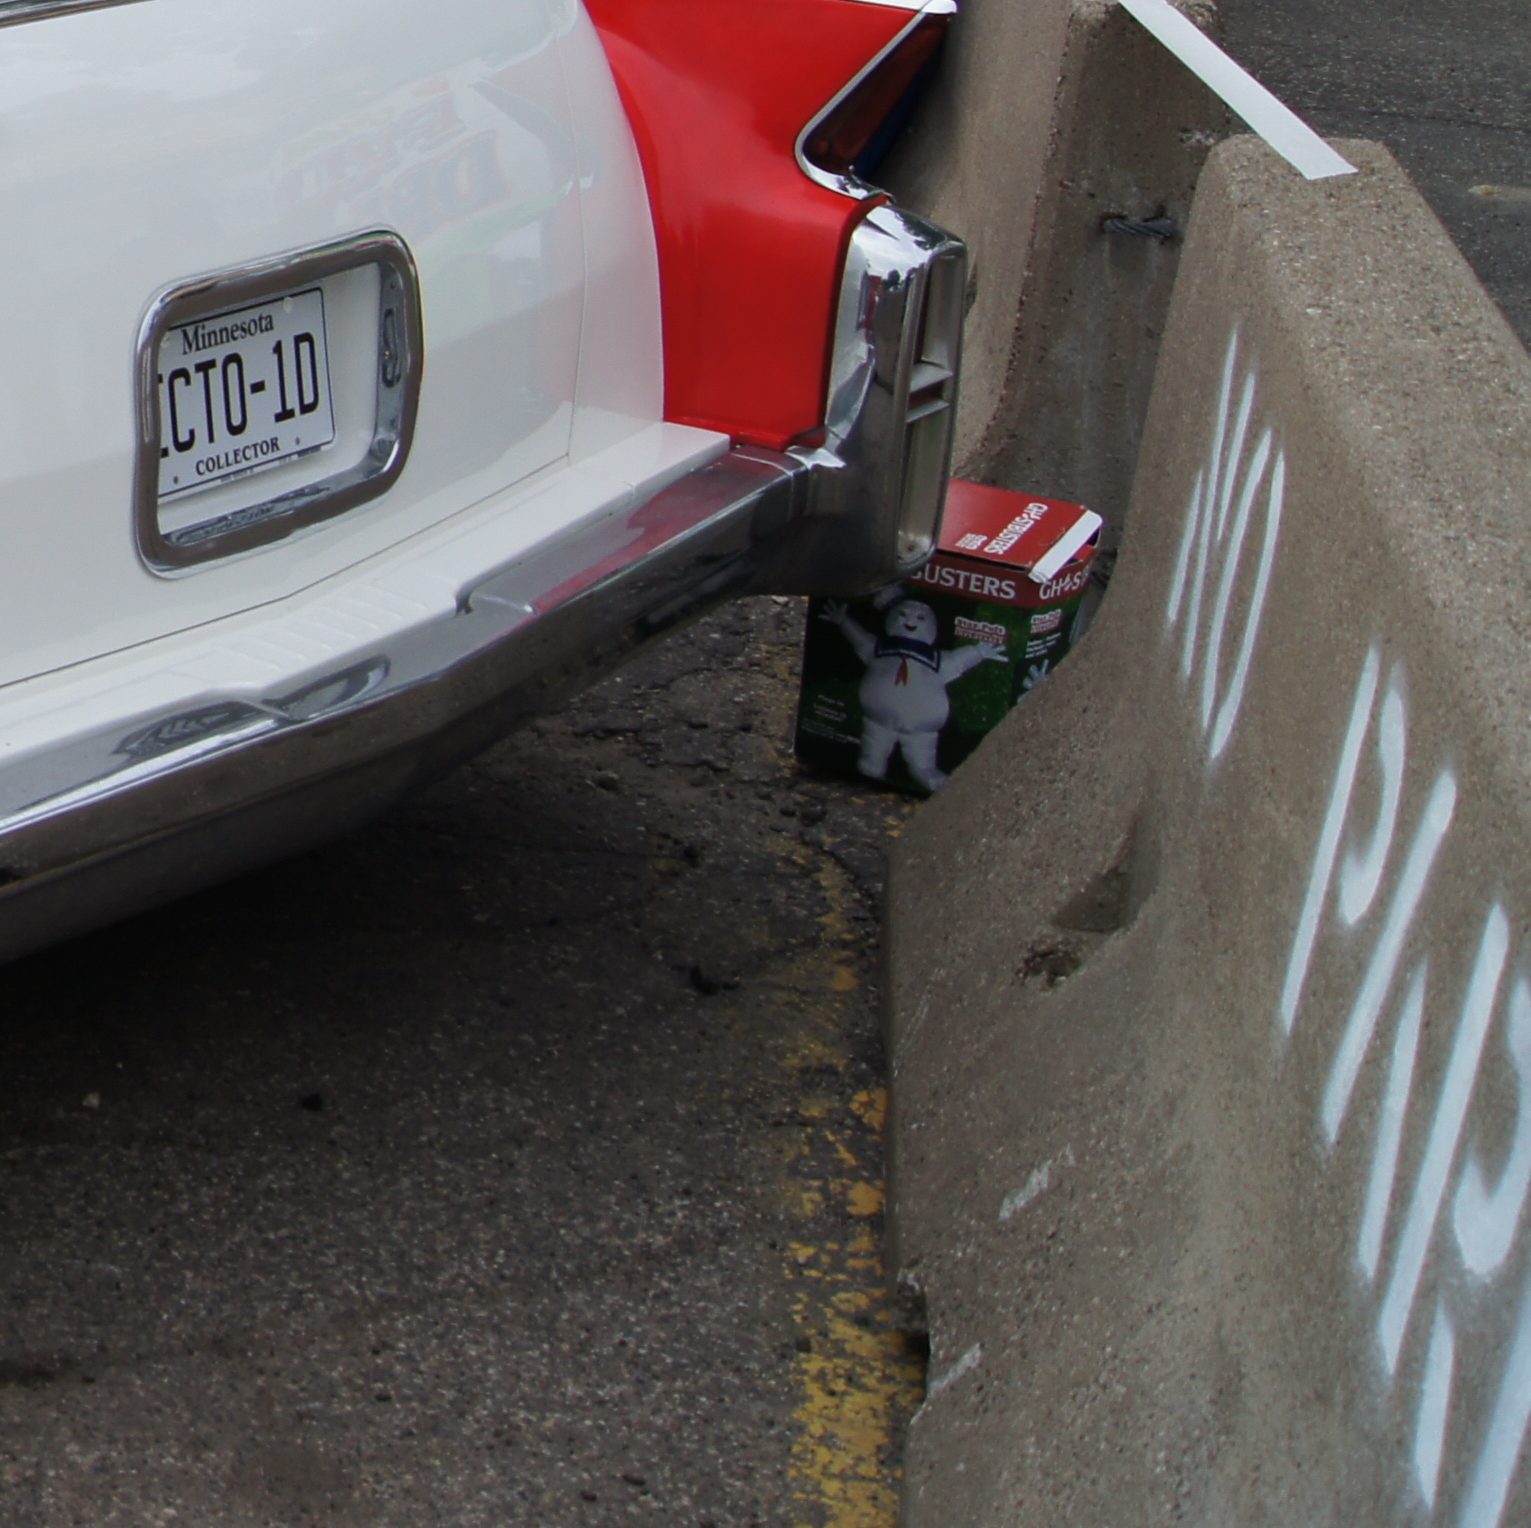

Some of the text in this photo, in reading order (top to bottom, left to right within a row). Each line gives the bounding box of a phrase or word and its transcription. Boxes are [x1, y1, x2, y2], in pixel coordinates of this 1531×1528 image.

[180, 311, 275, 356] Minnesota
[195, 436, 281, 477] COLLECTOR
[1279, 640, 1531, 1528] PAR
